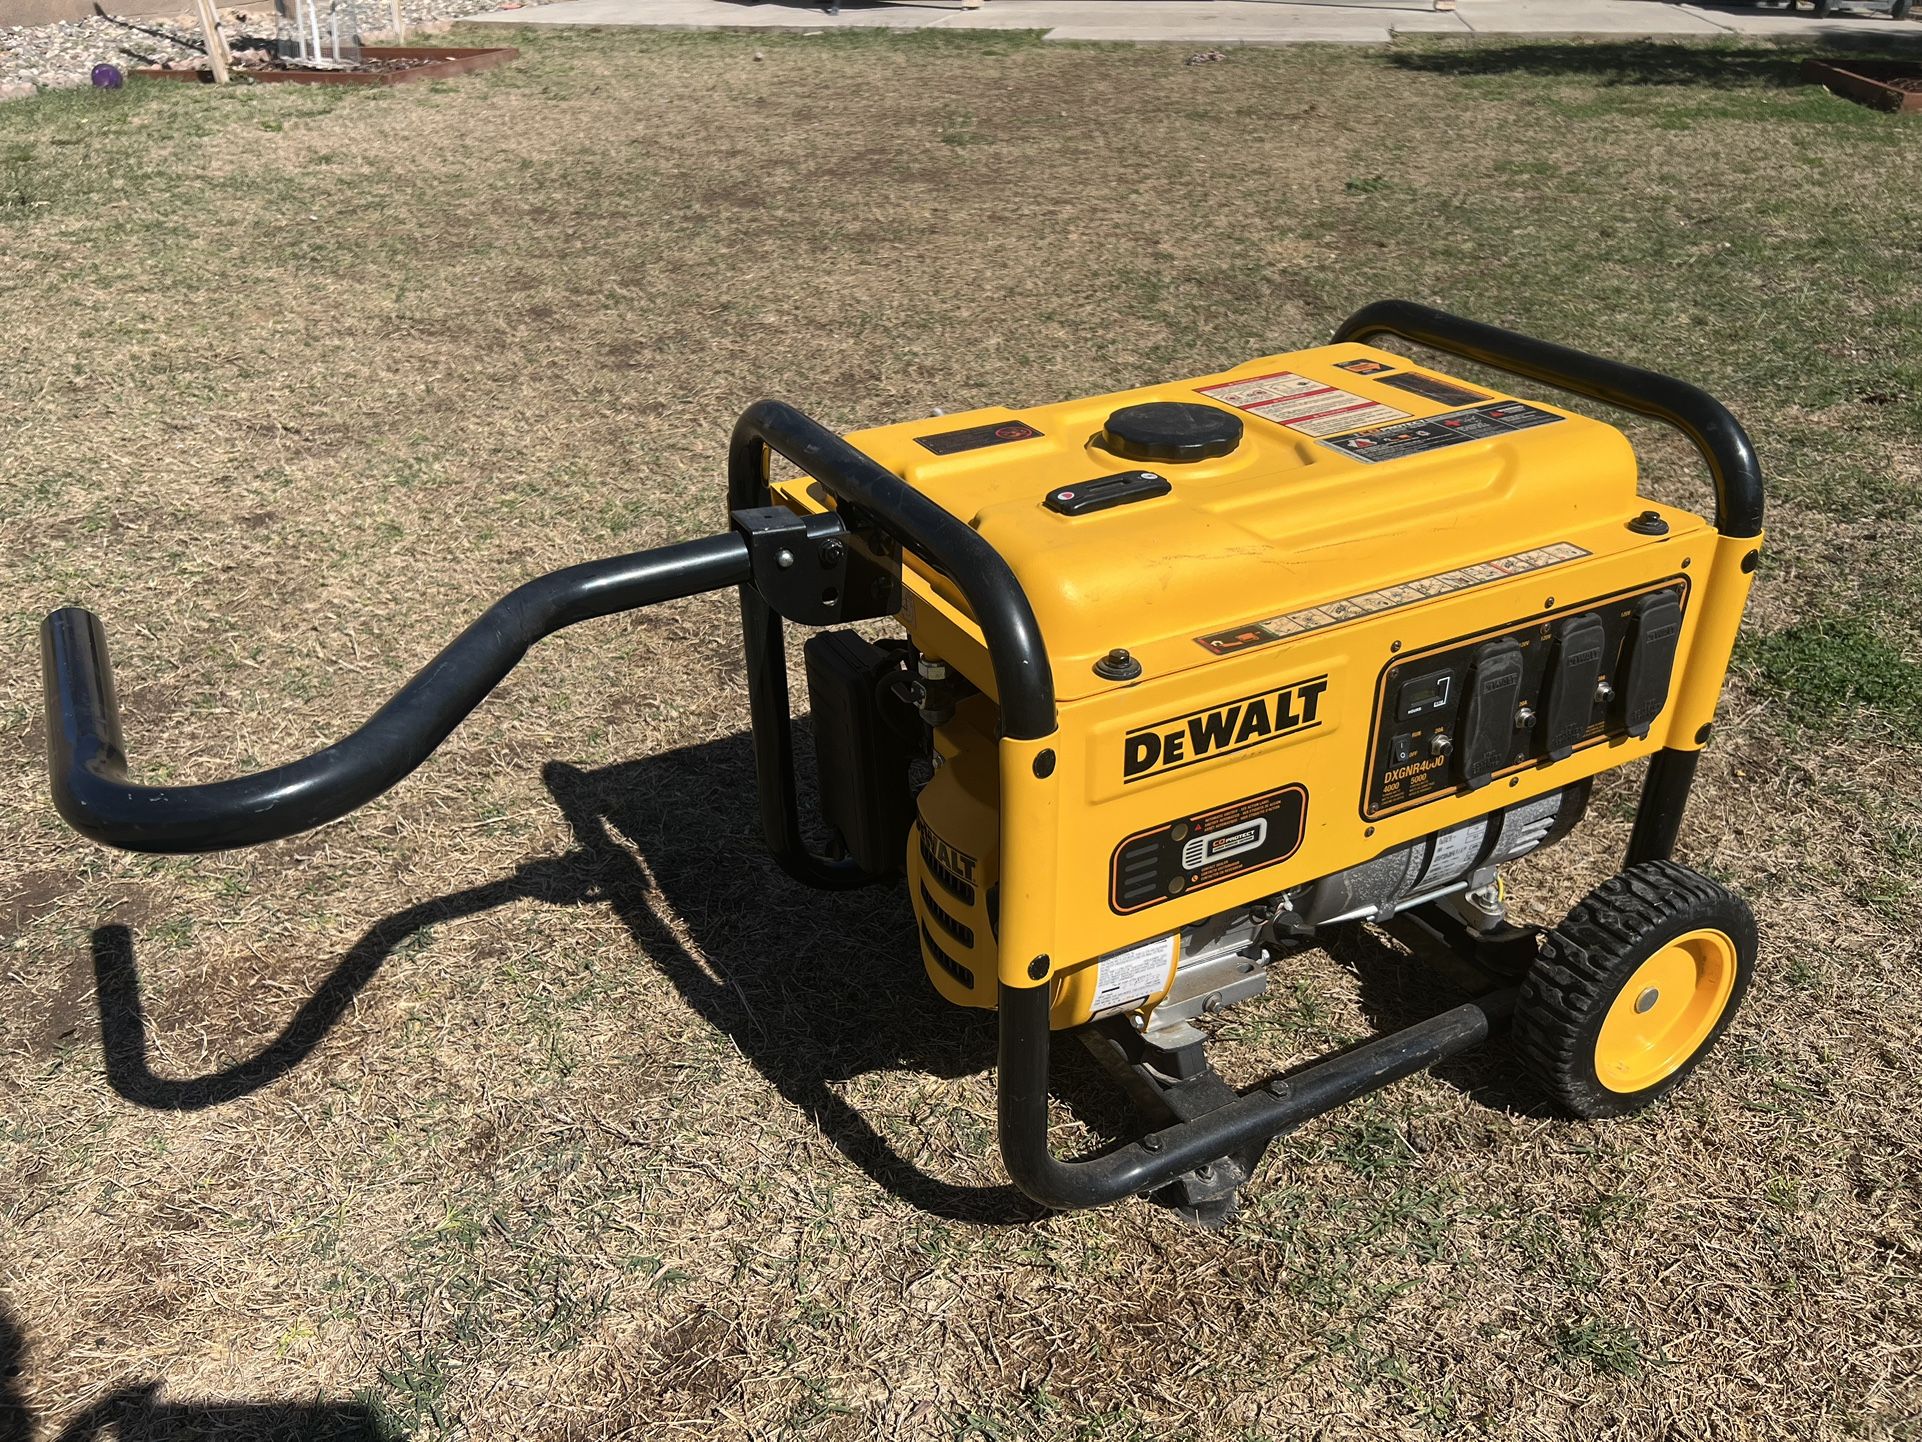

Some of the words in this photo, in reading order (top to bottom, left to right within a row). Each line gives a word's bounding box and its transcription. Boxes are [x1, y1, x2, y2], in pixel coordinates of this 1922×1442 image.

[1124, 680, 1327, 778] DEWALT
[1408, 750, 1418, 759] OFF
[1384, 754, 1444, 784] DXGNR4000
[1410, 772, 1427, 784] 5000
[1382, 782, 1400, 793] 4000
